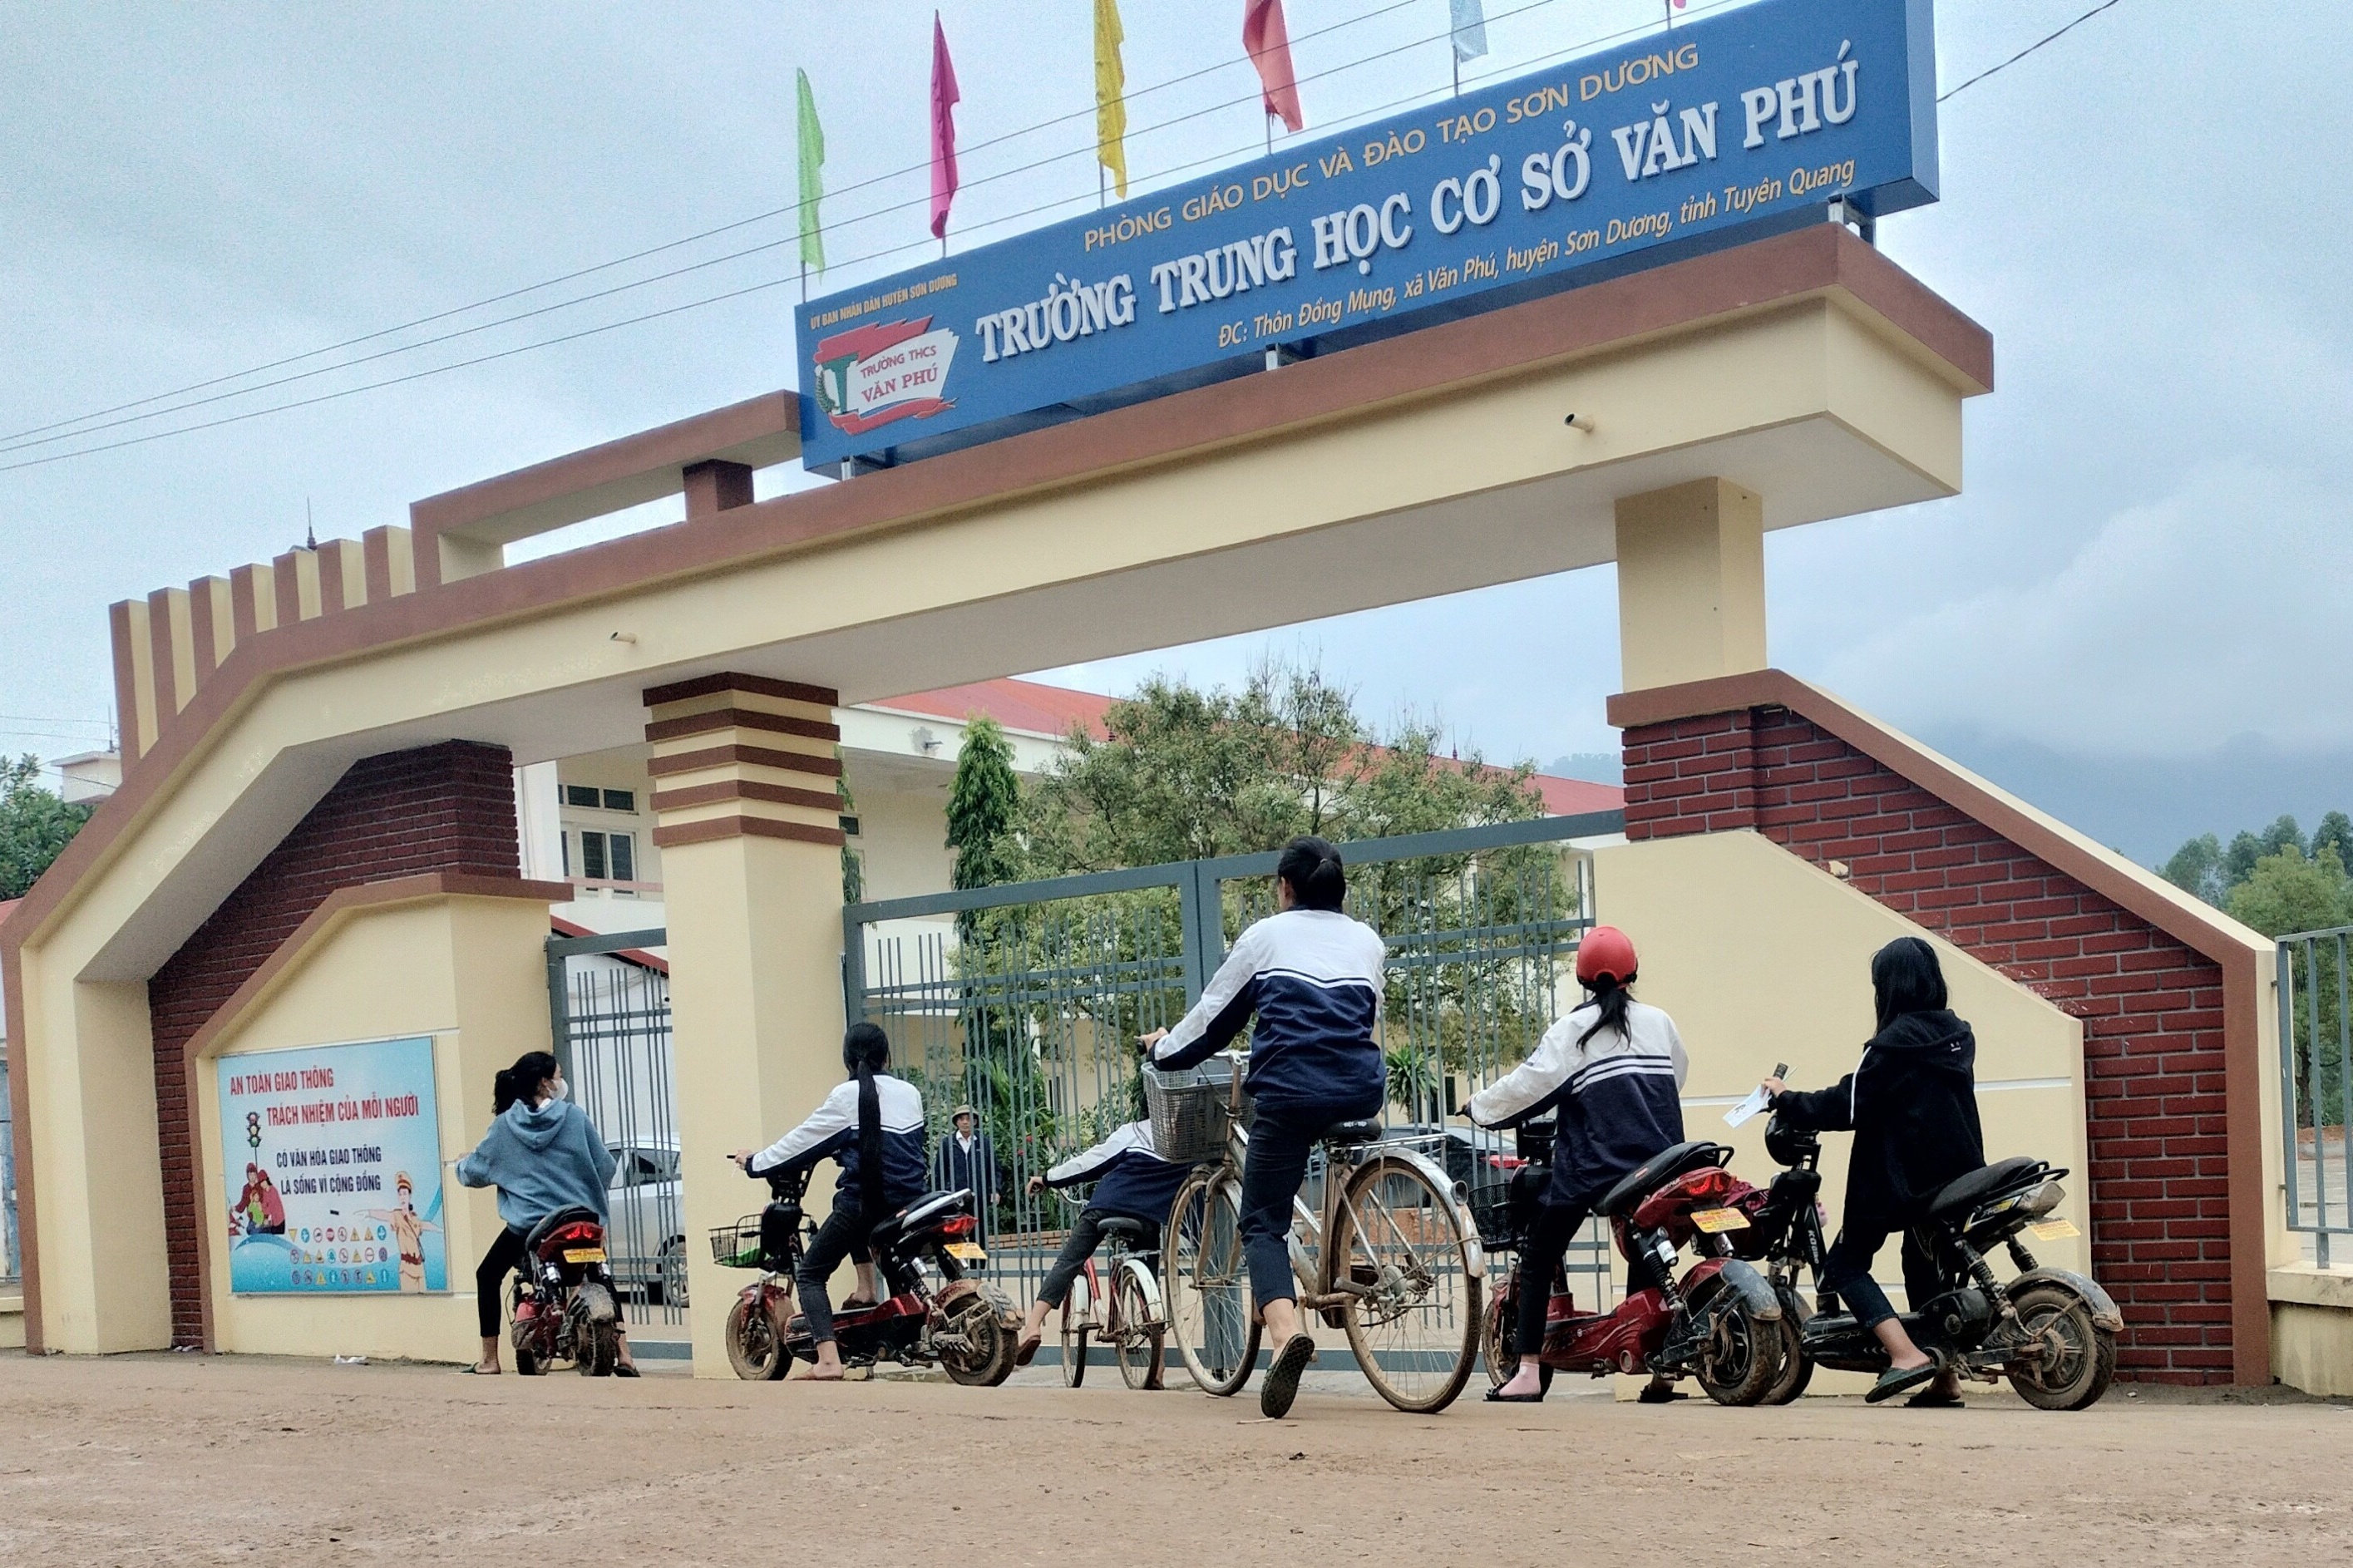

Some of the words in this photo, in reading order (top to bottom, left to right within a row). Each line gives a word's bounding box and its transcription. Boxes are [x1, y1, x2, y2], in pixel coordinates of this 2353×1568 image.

[1084, 206, 1172, 252] PHÒNG
[1182, 179, 1244, 222] GIÁO
[1253, 163, 1310, 201] DỤC
[1319, 146, 1354, 180] VÀ
[1363, 129, 1426, 167] ĐÀO
[1436, 107, 1497, 145] TẠO
[1507, 83, 1569, 124] SƠN
[1580, 42, 1699, 101] DƯƠNG
[975, 271, 1137, 363] TRƯỜNG
[1150, 225, 1298, 313] TRUNG
[1311, 192, 1413, 275] HỌC
[1430, 153, 1501, 235] CƠ
[1521, 119, 1592, 212] SỞ
[1611, 99, 1719, 181] VĂN
[1740, 39, 1859, 149] PHÚ
[1218, 320, 1248, 348] ĐC:
[1253, 308, 1293, 339] Thôn
[1298, 297, 1342, 327] Đồng
[1347, 287, 1397, 314] Mụng,
[1403, 273, 1423, 298] xã
[1428, 266, 1458, 293] Văn
[1463, 251, 1499, 283] Phú,
[1506, 238, 1559, 273] huyện
[1564, 226, 1600, 255] Sơn
[1606, 211, 1673, 245] Dương,
[1680, 191, 1717, 224] tỉnh
[1724, 177, 1782, 214] Tuyên
[1789, 159, 1855, 195] Quang
[822, 310, 838, 326] BAN
[840, 301, 861, 322] NHÂN
[864, 296, 881, 314] DÂN
[882, 287, 909, 307] HUYỆN
[910, 282, 928, 299] SƠN
[929, 274, 958, 293] DƯƠNG
[861, 356, 905, 378] TRƯỜNG
[908, 345, 937, 362] THCS
[861, 377, 896, 402] VĂN
[902, 362, 938, 389] PHÚ
[230, 1076, 244, 1096] AN
[245, 1070, 272, 1094] TOÀN
[274, 1071, 298, 1092] GIAO
[300, 1065, 334, 1090] THÔNG
[267, 1102, 298, 1127] TRÁCH
[301, 1099, 335, 1127] NHIỆM
[338, 1094, 359, 1121] CỦA
[362, 1091, 382, 1119] MỖI
[385, 1090, 419, 1117] NGƯỜI
[276, 1148, 288, 1168] CÓ
[290, 1147, 308, 1167] VĂN
[309, 1146, 328, 1166] HÓA
[329, 1148, 350, 1166] GIAO
[352, 1143, 382, 1164] THÔNG
[281, 1176, 291, 1195] LÀ
[294, 1172, 317, 1195] SỐNG
[318, 1173, 328, 1193] VÌ
[329, 1173, 353, 1196] CỘNG
